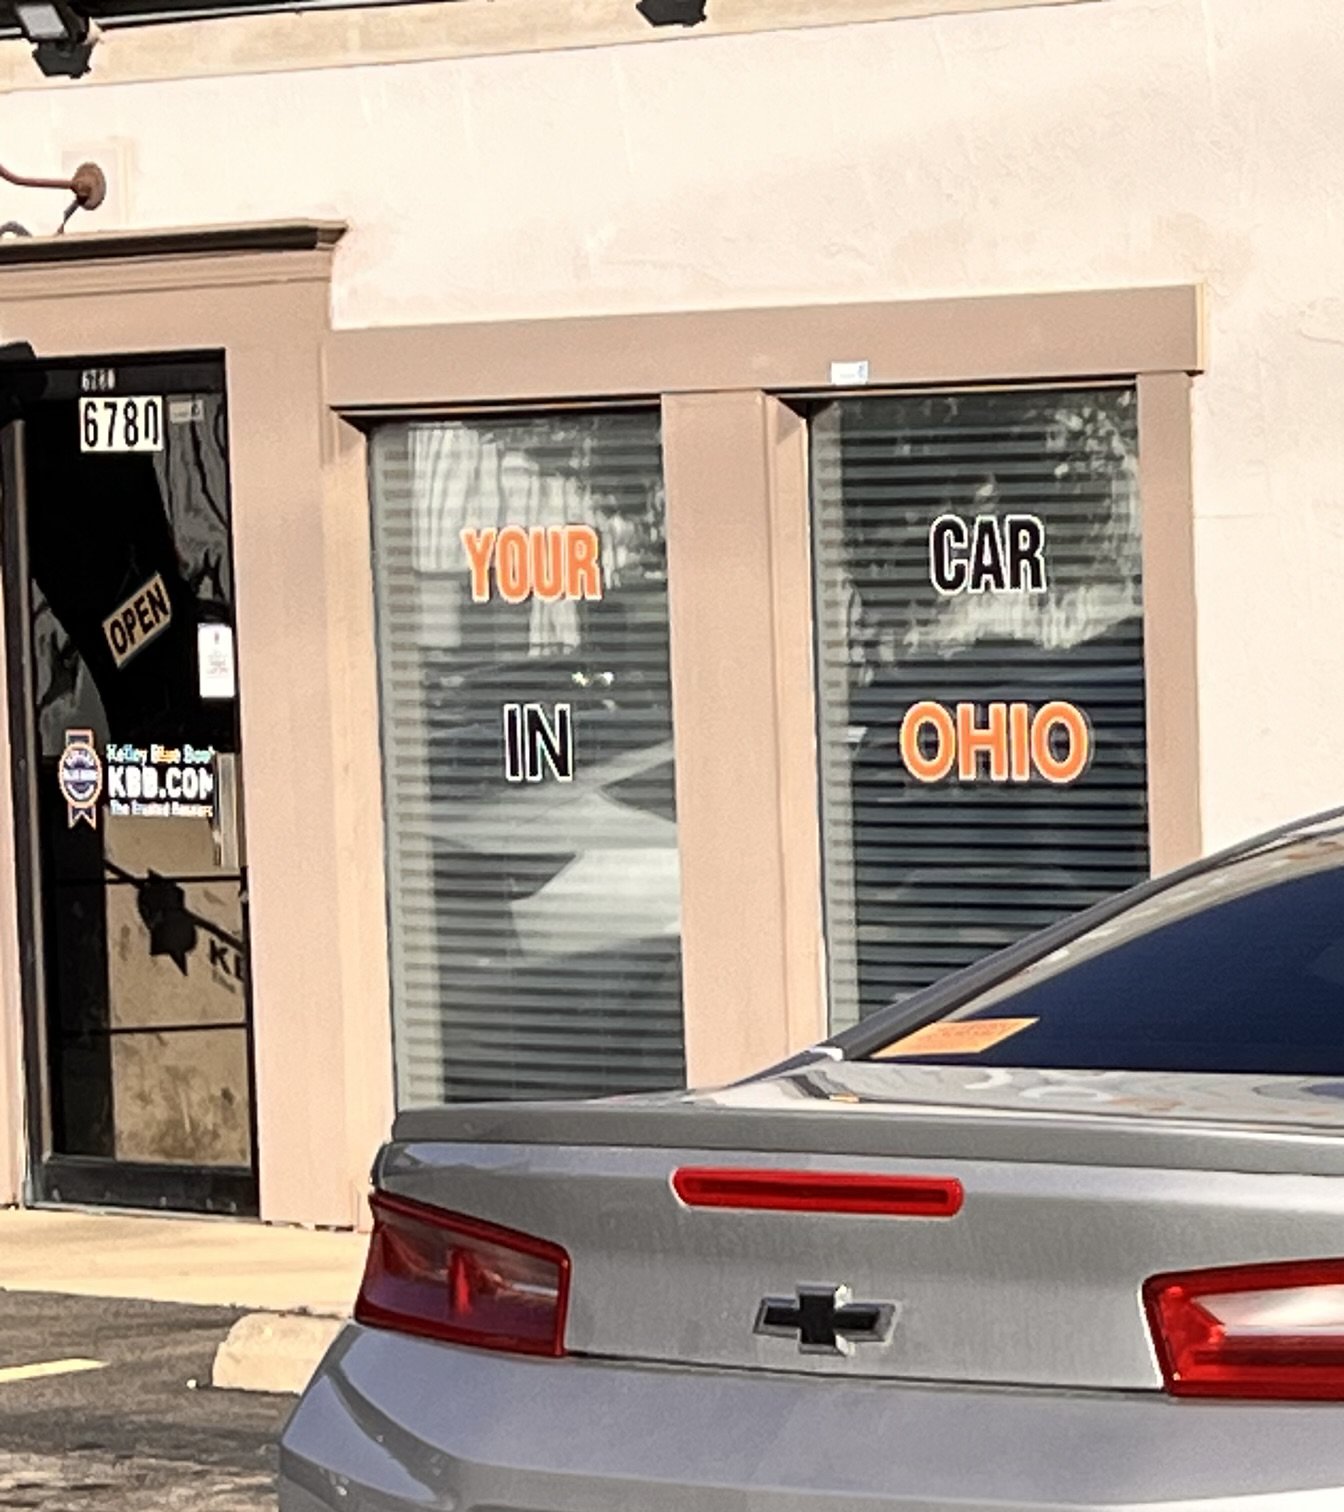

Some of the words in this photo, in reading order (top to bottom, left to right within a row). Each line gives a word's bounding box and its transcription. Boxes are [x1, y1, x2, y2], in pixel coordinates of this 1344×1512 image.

[83, 400, 159, 448] 6780
[460, 524, 603, 604] YOUR
[928, 514, 1047, 596] CAR
[109, 582, 169, 656] OPEN
[503, 703, 574, 783] IN
[900, 701, 1089, 784] OHIO
